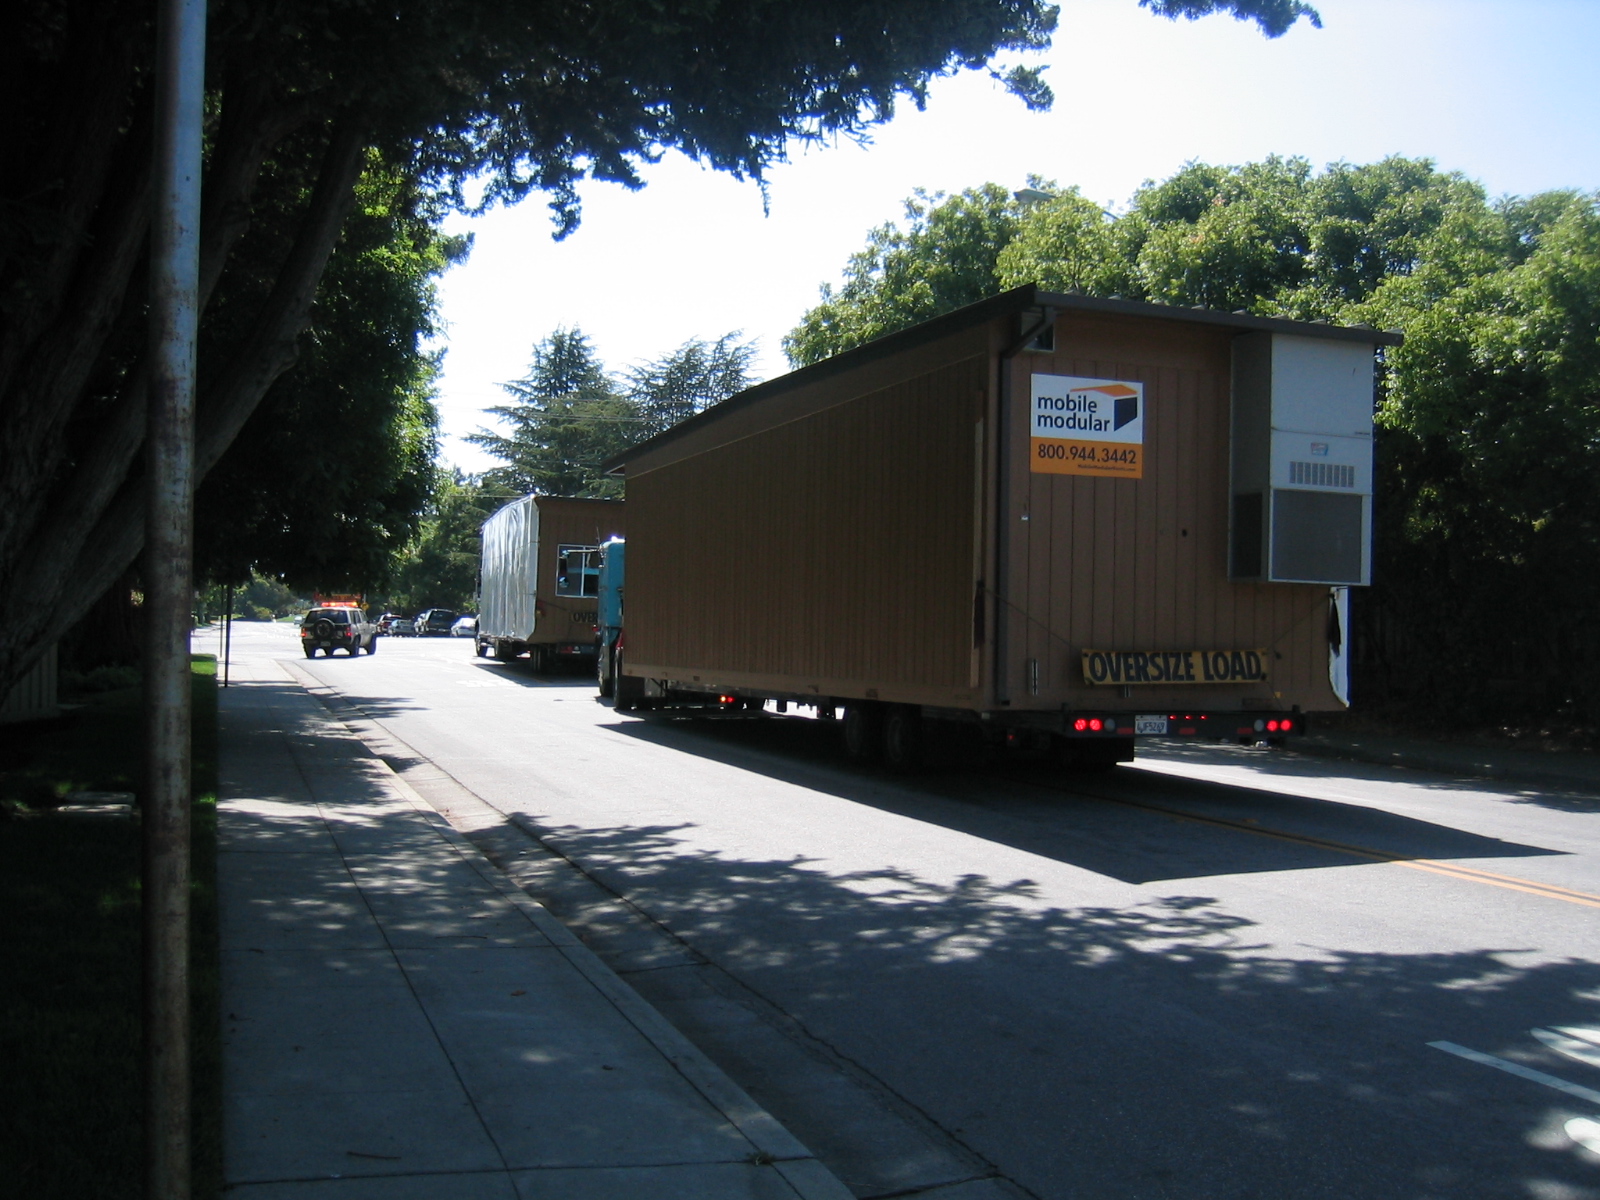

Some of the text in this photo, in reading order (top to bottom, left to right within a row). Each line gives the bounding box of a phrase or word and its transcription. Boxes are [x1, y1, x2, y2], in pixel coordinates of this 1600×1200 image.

[1037, 394, 1098, 413] mobile
[1037, 412, 1110, 432] modular
[1038, 443, 1137, 465] 800.944.3442
[1088, 651, 1262, 683] OVERSIZE LOAD
